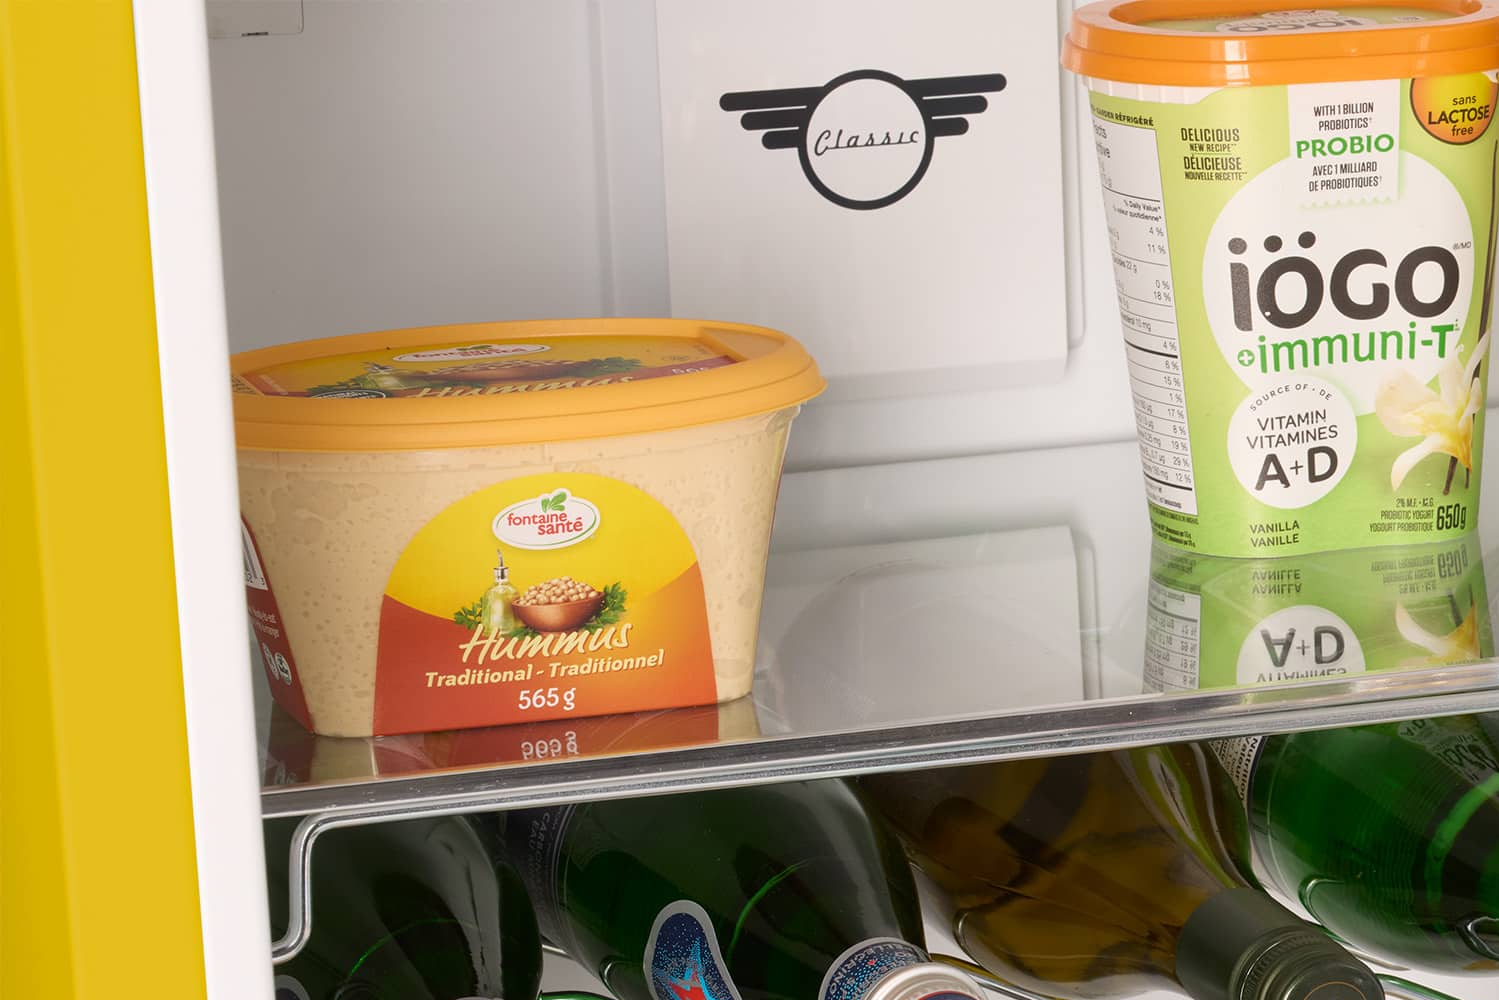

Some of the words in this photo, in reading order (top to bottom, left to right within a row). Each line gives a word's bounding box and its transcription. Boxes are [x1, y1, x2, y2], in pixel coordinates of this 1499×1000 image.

[1452, 95, 1477, 105] sans
[1313, 105, 1336, 117] WITH
[1342, 102, 1374, 115] BILLION
[1427, 104, 1490, 125] LACTOSE
[1181, 128, 1240, 142] DELICIOUS
[1450, 124, 1475, 137] free
[815, 128, 921, 157] Classic
[1189, 143, 1205, 152] NEW
[1296, 134, 1395, 159] PROBIO
[1183, 154, 1242, 171] DÉLICIEUSE
[1312, 164, 1332, 176] AVEC
[1340, 161, 1378, 175] MILLIARD
[1185, 172, 1214, 181] NOUVELLE
[1308, 178, 1319, 192] DE
[1249, 385, 1290, 412] SOURCE
[1295, 383, 1308, 391] OF
[1319, 389, 1333, 401] DE
[1257, 409, 1327, 431] VITAMIN
[1246, 425, 1338, 449] VITAMINES
[506, 511, 568, 529] fontaine
[1380, 510, 1411, 520] PROBIOTIC
[1412, 509, 1434, 520] YOGURT
[537, 516, 584, 536] santé
[1250, 520, 1300, 535] VANILLA
[1397, 522, 1433, 532] PROBIOTIQUE
[1251, 534, 1300, 548] VANILLE
[458, 621, 634, 666] Hummus
[425, 663, 533, 688] Traditional
[548, 649, 665, 677] Traditionnel
[518, 688, 560, 710] 565
